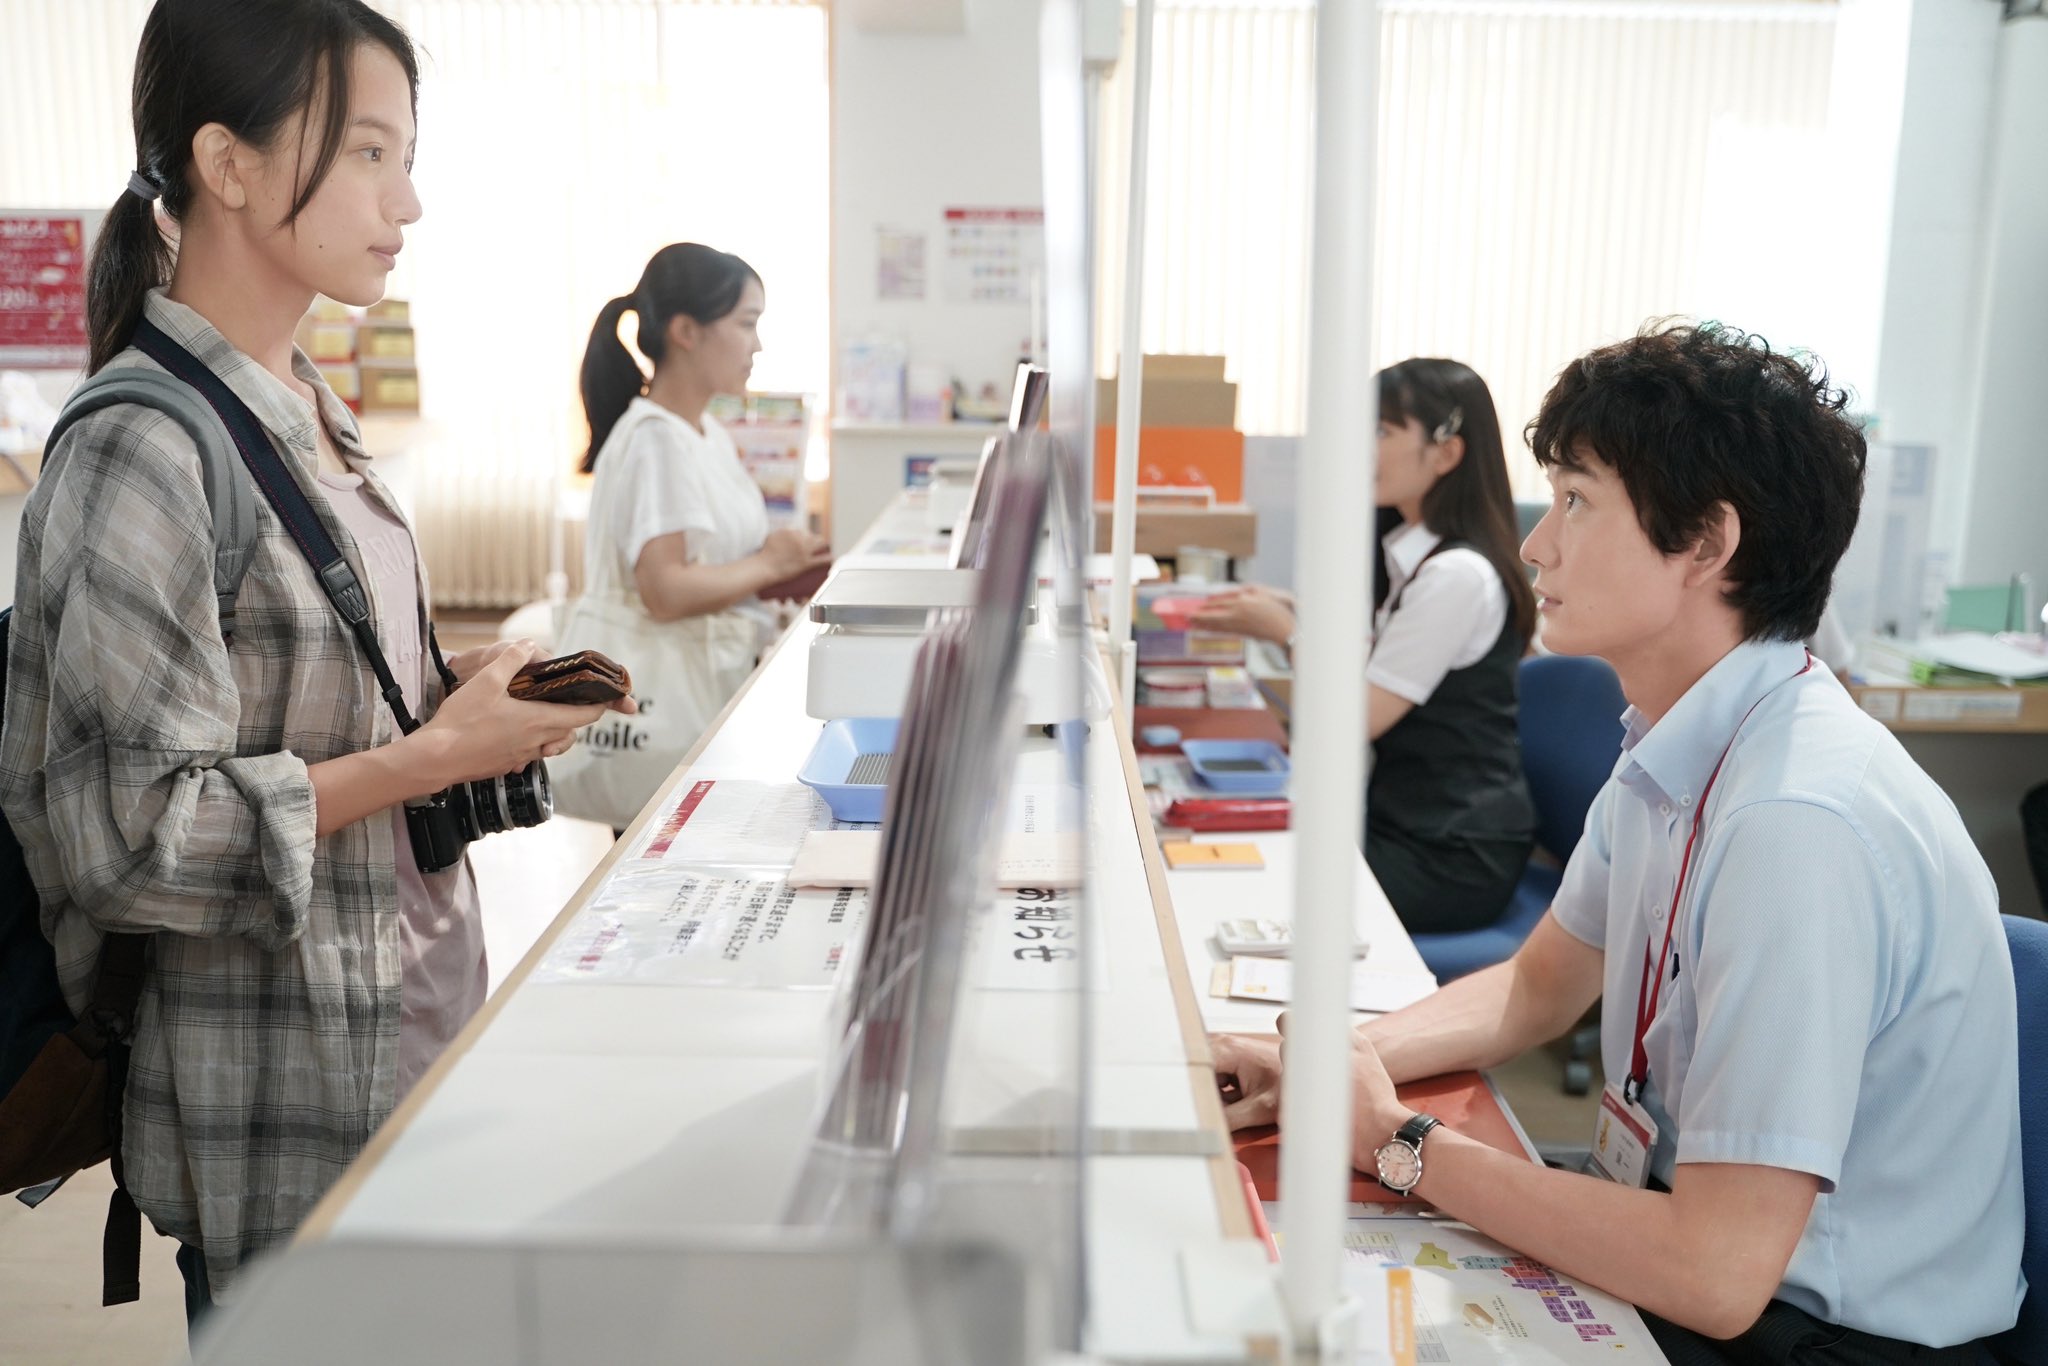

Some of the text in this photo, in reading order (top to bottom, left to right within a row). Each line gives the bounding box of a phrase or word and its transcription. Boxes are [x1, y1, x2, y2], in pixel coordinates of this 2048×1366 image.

[576, 721, 650, 750] toile
[757, 884, 798, 943] の時間を過ぎますと、
[1013, 887, 1056, 963] お知らせ
